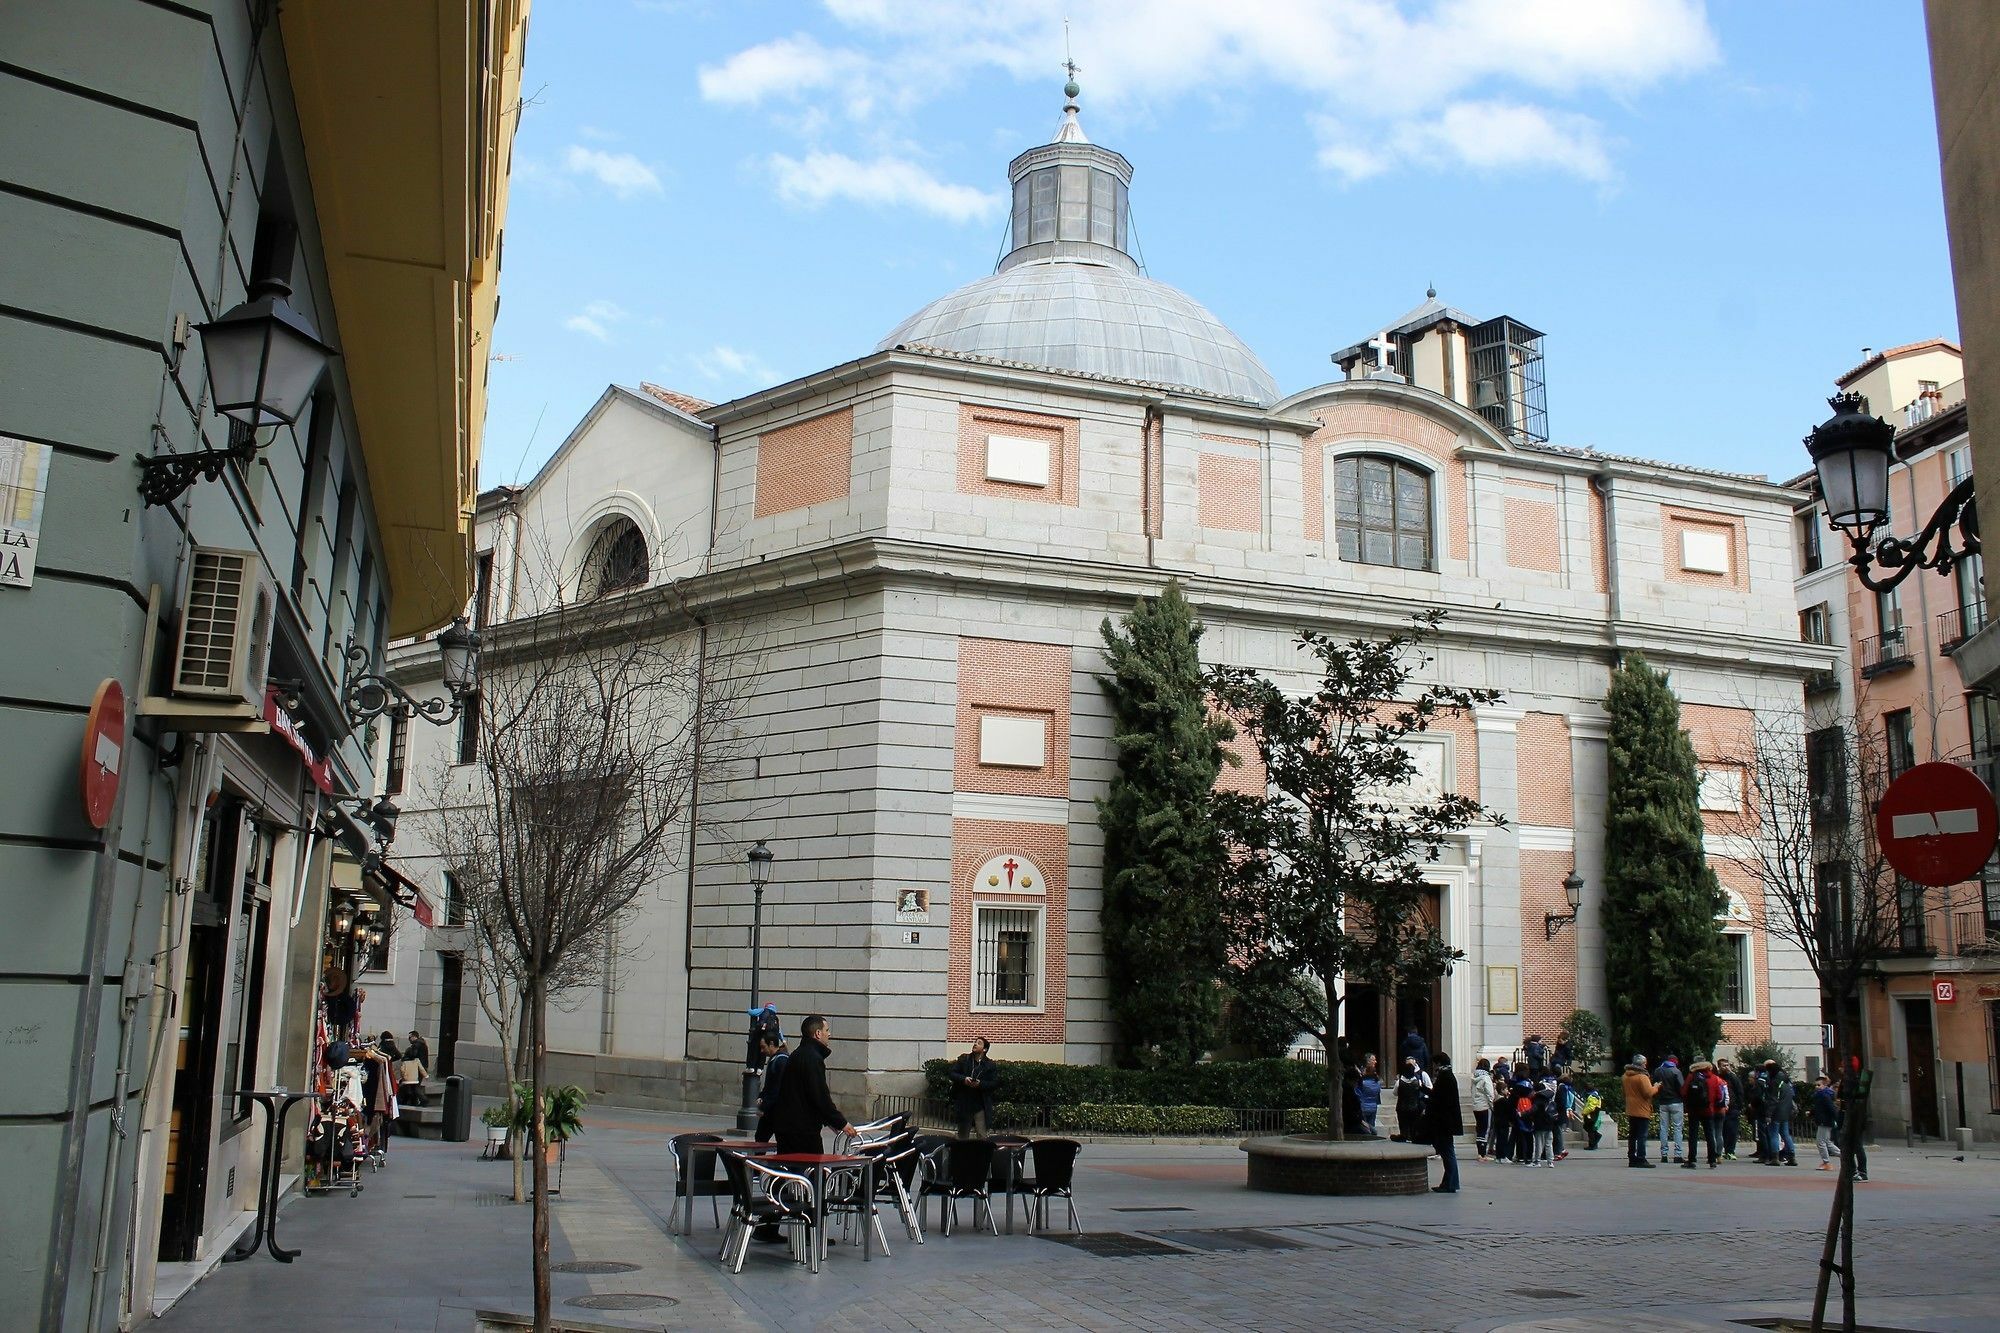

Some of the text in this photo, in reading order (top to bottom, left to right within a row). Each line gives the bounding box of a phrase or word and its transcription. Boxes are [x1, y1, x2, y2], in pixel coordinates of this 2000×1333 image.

[122, 508, 130, 523] 1
[1, 528, 31, 548] LA
[0, 550, 24, 579] A
